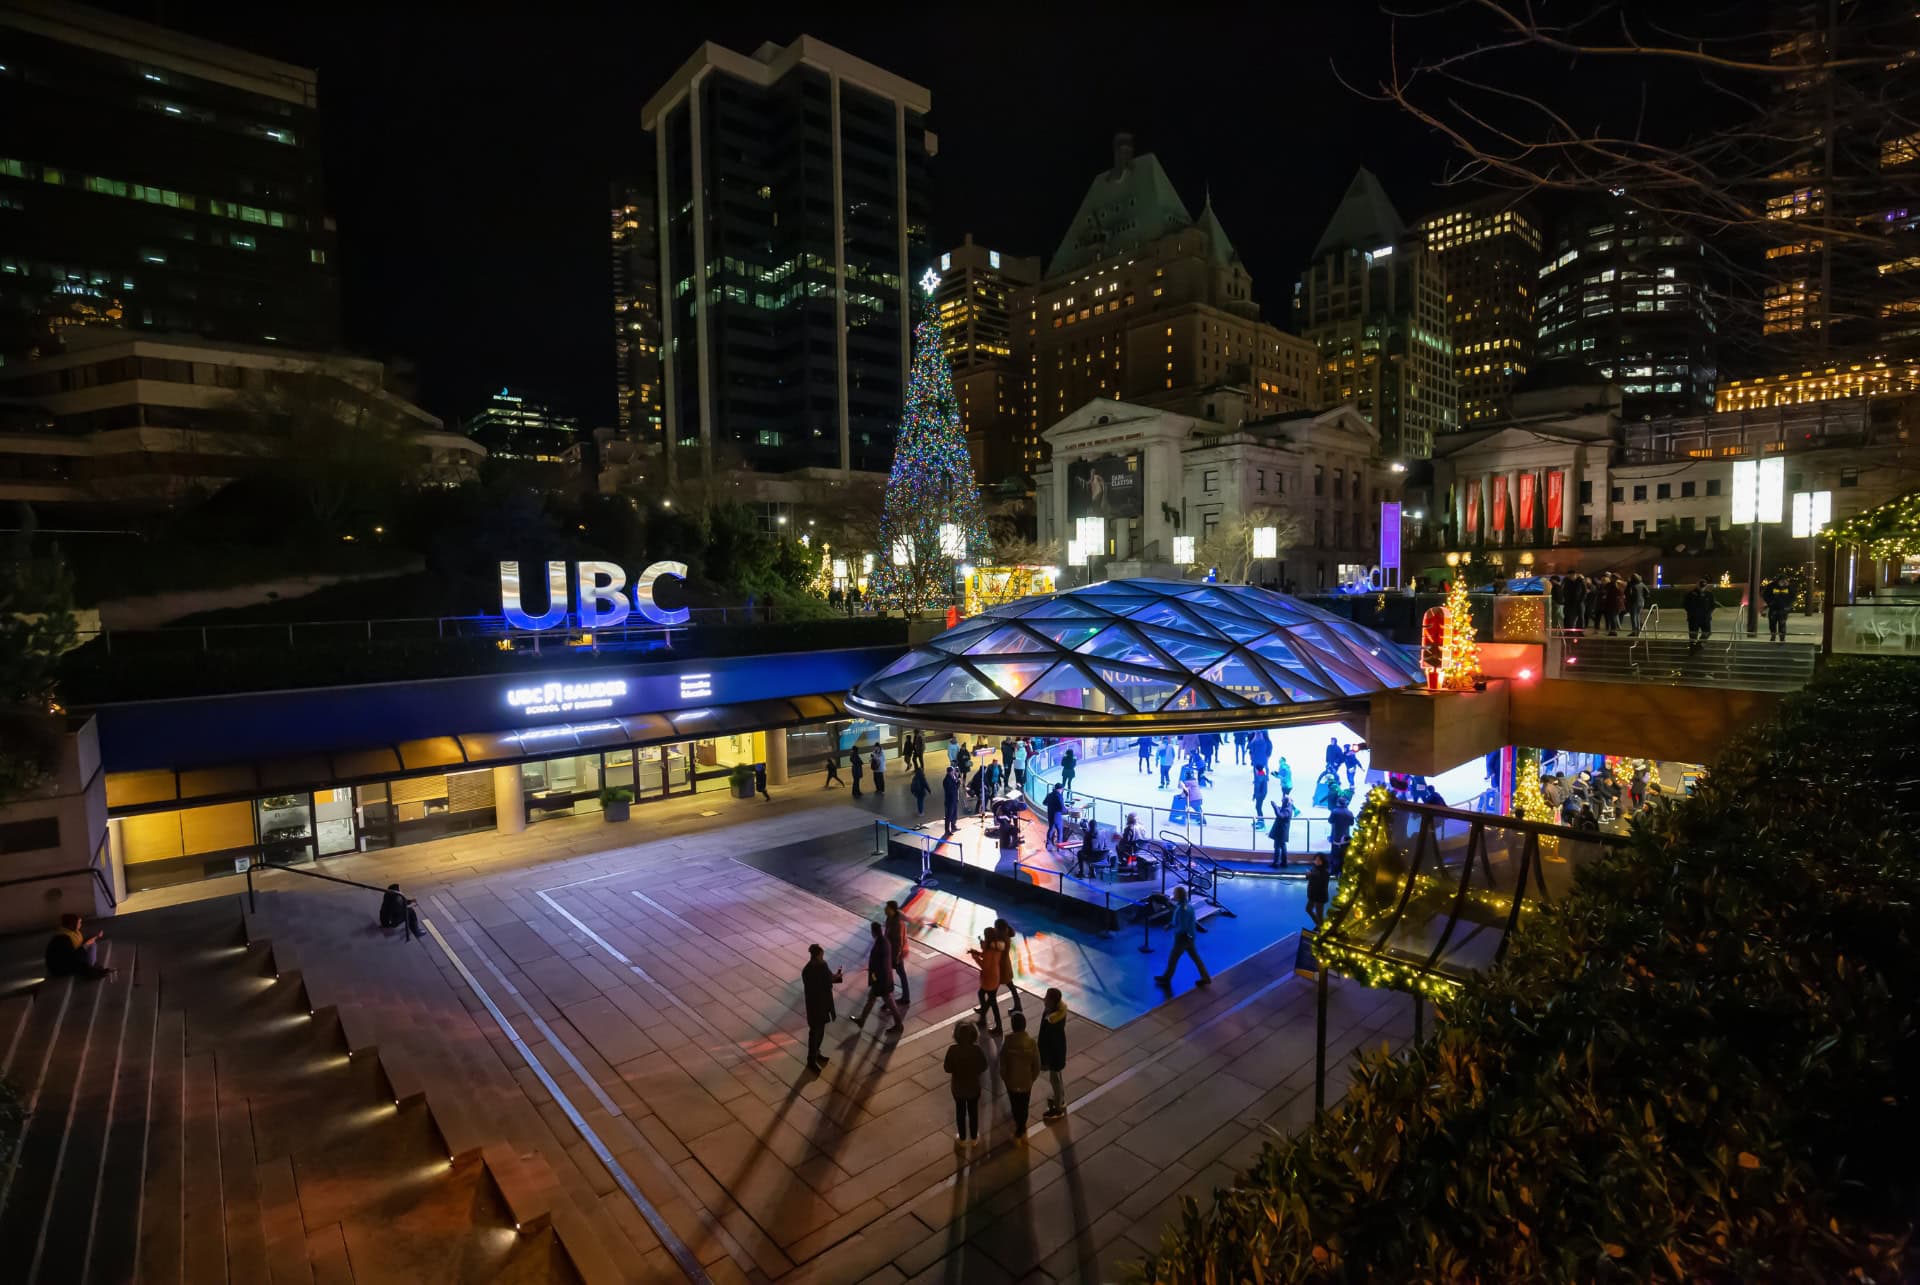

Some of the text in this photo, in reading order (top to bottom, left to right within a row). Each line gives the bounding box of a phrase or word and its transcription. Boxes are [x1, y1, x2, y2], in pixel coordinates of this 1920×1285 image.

[500, 560, 690, 630] UBC
[508, 681, 627, 706] UBC SAUDER
[526, 704, 560, 715] SCHOOL
[561, 702, 573, 711] OF
